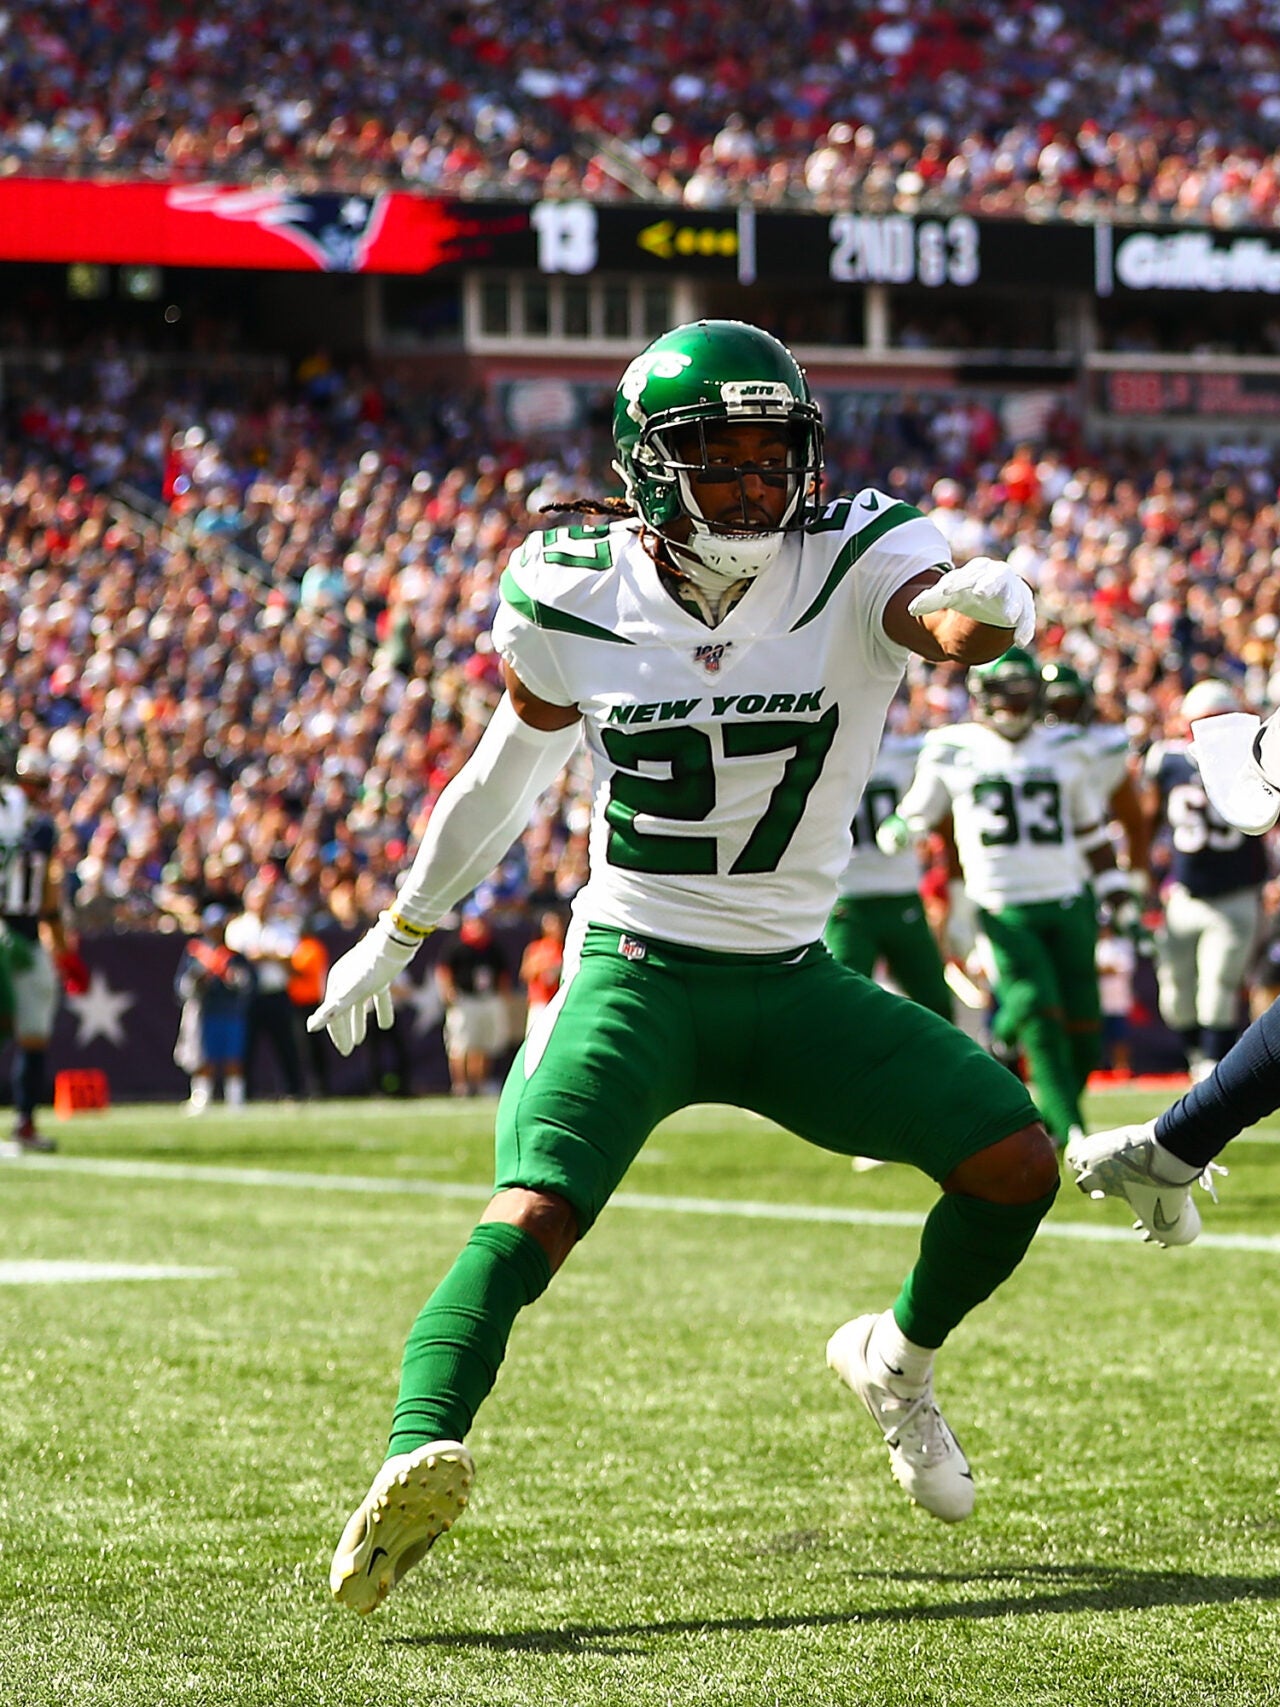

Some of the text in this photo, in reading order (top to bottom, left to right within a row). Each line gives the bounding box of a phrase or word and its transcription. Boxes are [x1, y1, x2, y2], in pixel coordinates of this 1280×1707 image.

[740, 386, 774, 396] JETS
[607, 685, 827, 724] NEW YORK
[600, 701, 840, 876] 27
[972, 775, 1064, 846] 33
